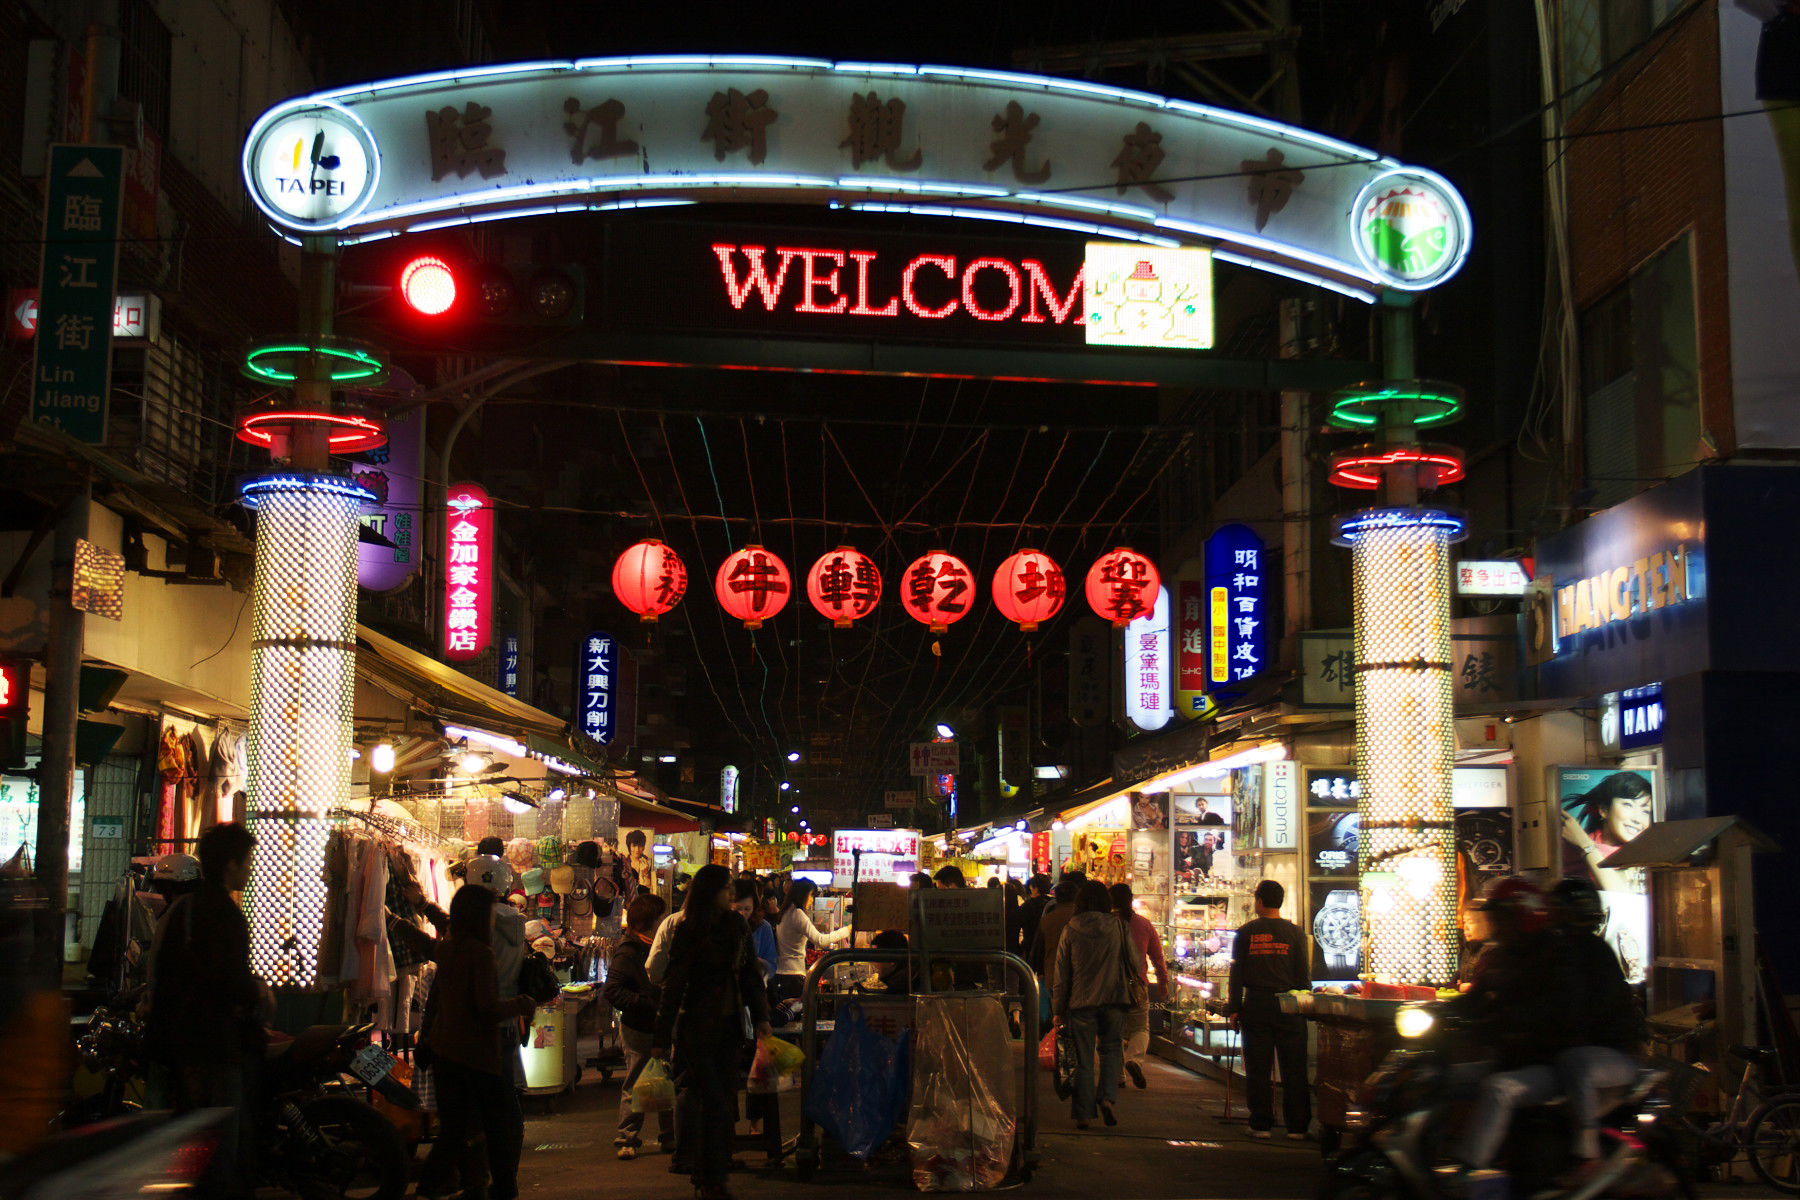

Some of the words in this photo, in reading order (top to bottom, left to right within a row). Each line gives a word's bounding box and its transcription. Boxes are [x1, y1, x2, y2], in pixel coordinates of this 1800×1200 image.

[276, 177, 345, 196] TAIPEI
[425, 88, 1304, 234] 臨江街觀光夜市
[56, 195, 105, 351] 臨江街
[38, 390, 102, 413] Jiang
[39, 366, 76, 383] Lin
[394, 513, 412, 563] 娃娃屋
[728, 553, 788, 612] 牛
[820, 557, 881, 614] 轉
[909, 561, 968, 614] 乾
[1099, 557, 1150, 620] 迎春
[1461, 568, 1520, 587] 緊急出口
[1556, 566, 1633, 639] HANG
[1634, 545, 1688, 612] TEN
[1232, 549, 1260, 681] 明和百貨皮件
[1139, 633, 1160, 711] 曼黛瑪璉
[1623, 703, 1664, 737] HAN
[1561, 773, 1590, 781] SEIKO
[98, 826, 117, 837] 73
[1272, 776, 1287, 844] swatch
